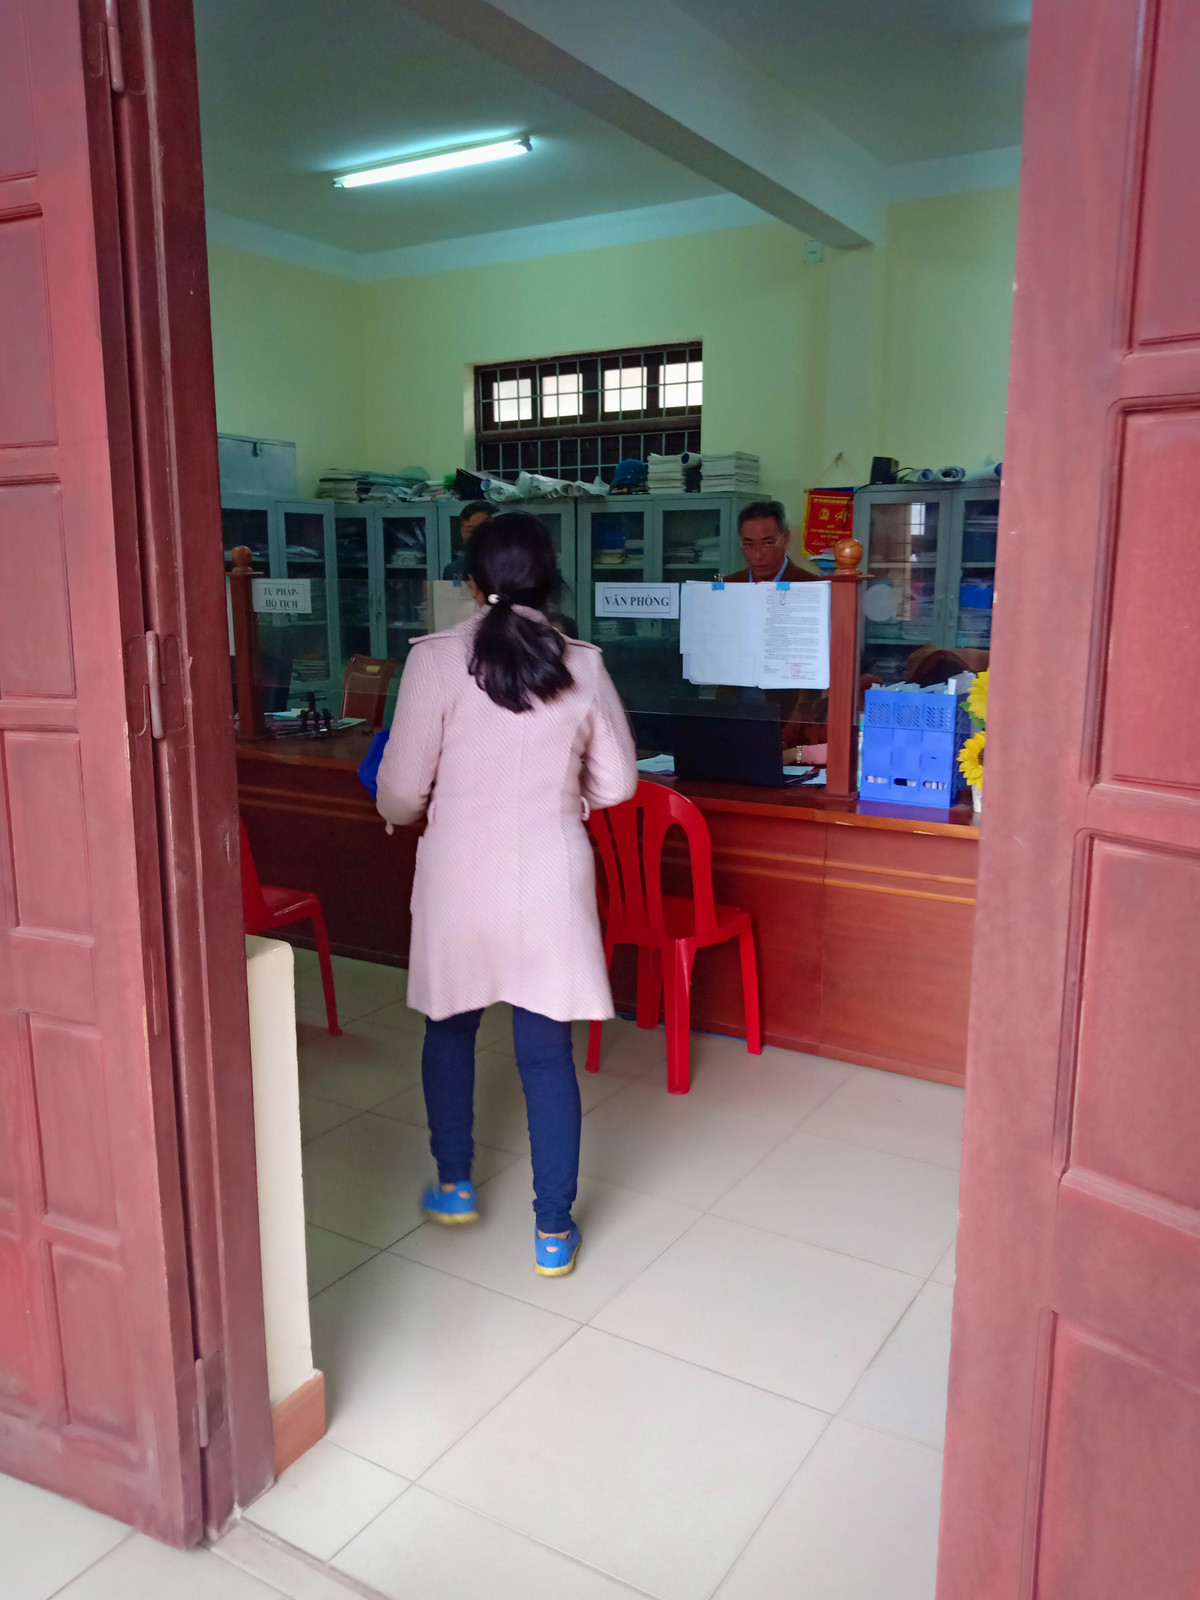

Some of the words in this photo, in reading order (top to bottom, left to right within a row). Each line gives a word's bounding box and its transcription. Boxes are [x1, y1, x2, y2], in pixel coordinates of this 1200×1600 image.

[279, 600, 298, 610] TỊCH
[605, 594, 627, 606] VĂN
[630, 594, 669, 607] PHÒNG
